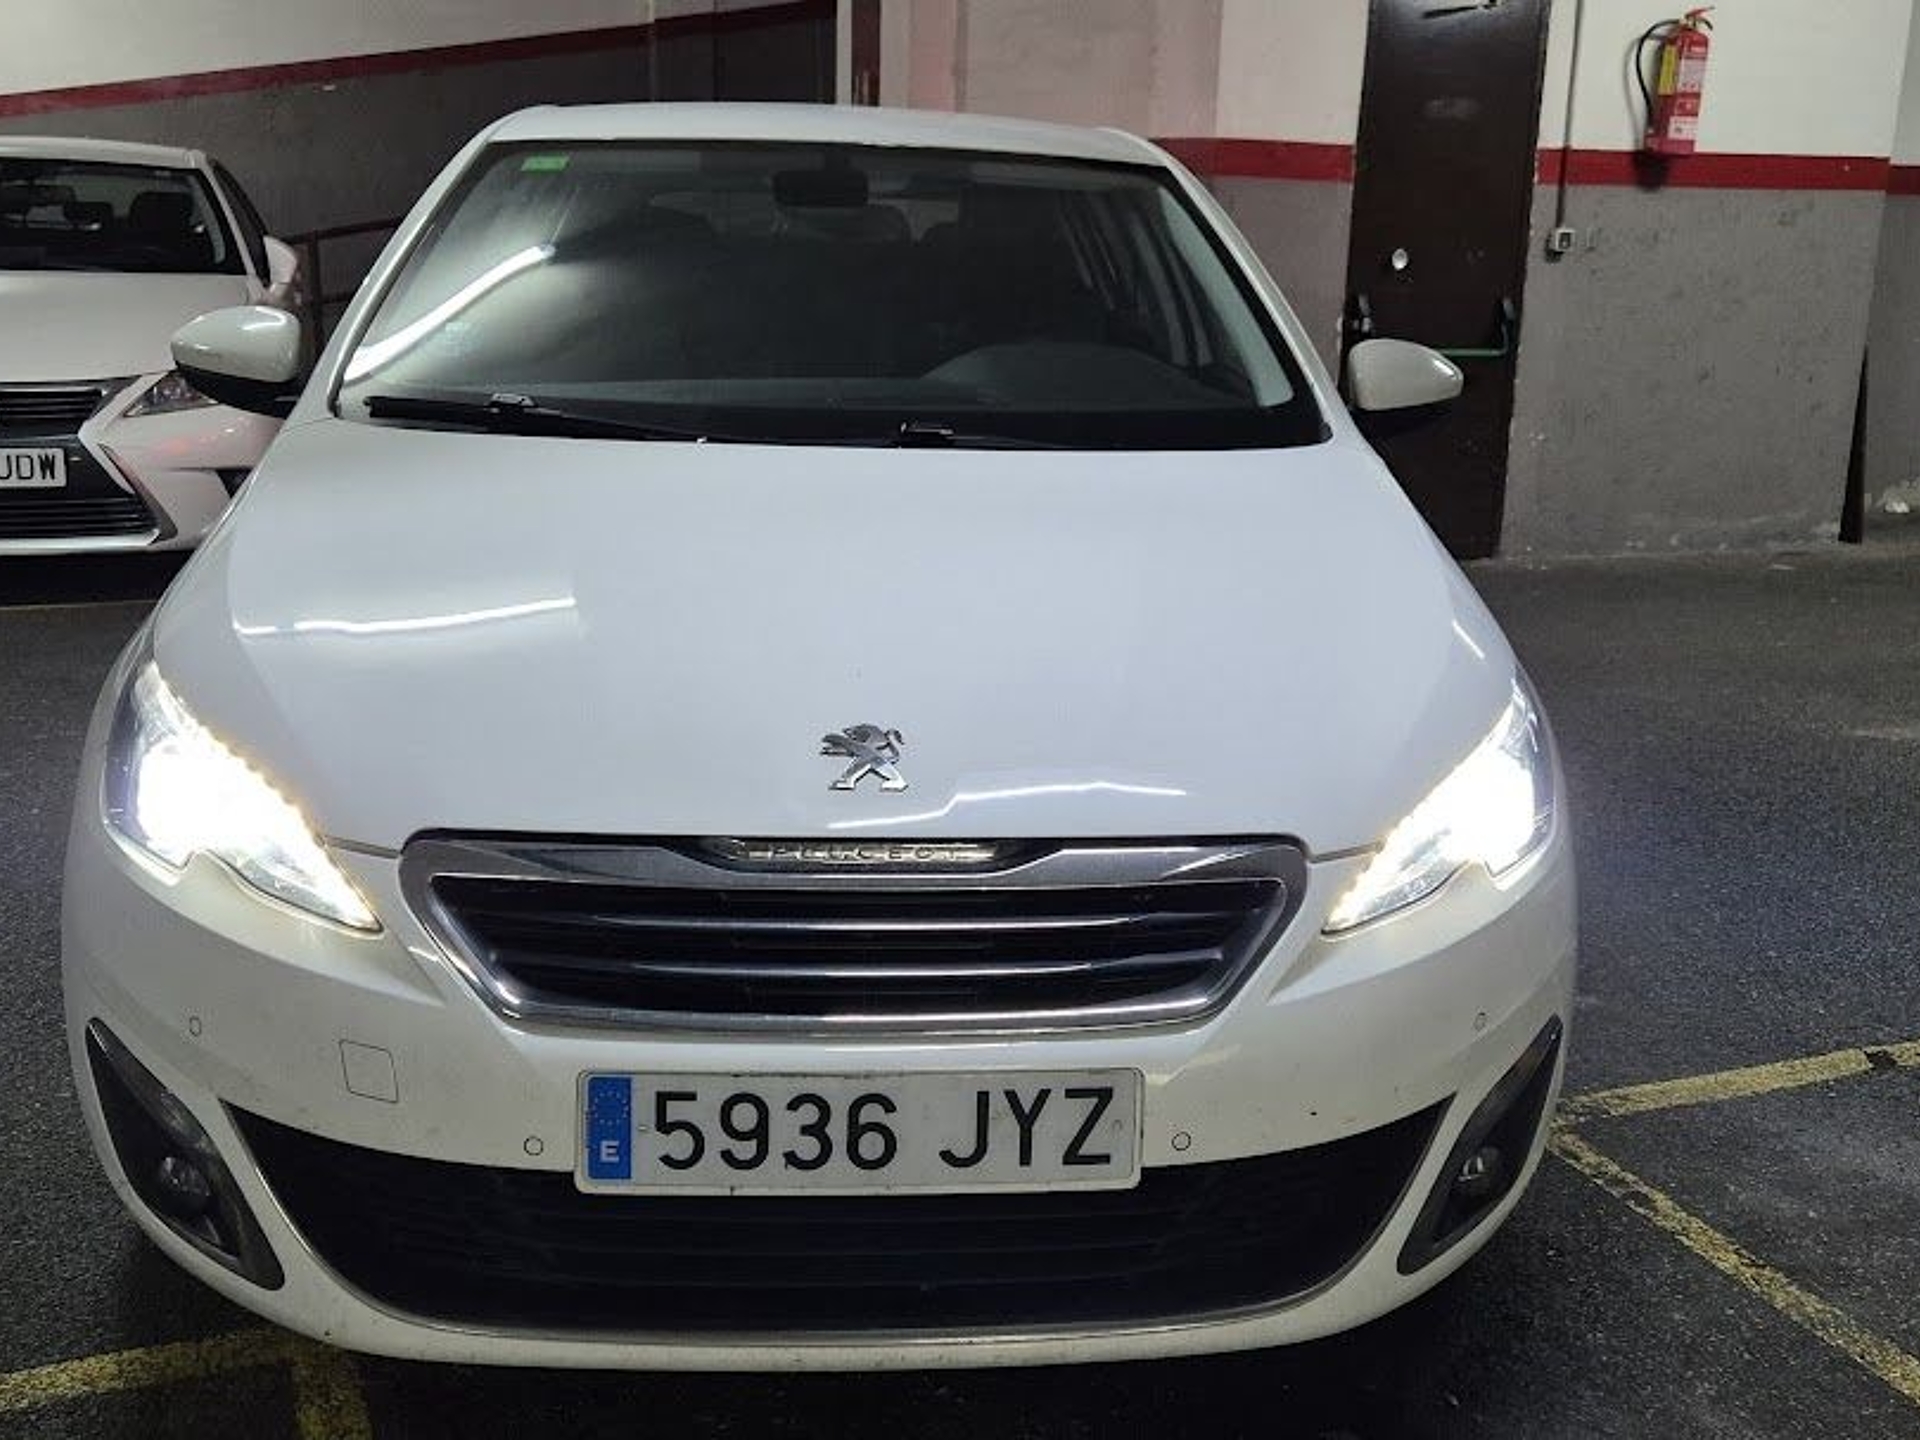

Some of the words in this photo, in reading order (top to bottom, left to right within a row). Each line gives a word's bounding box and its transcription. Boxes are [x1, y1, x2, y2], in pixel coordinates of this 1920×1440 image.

[601, 1140, 620, 1163] E
[654, 1091, 898, 1171] 5936
[938, 1086, 1115, 1169] JYZ
